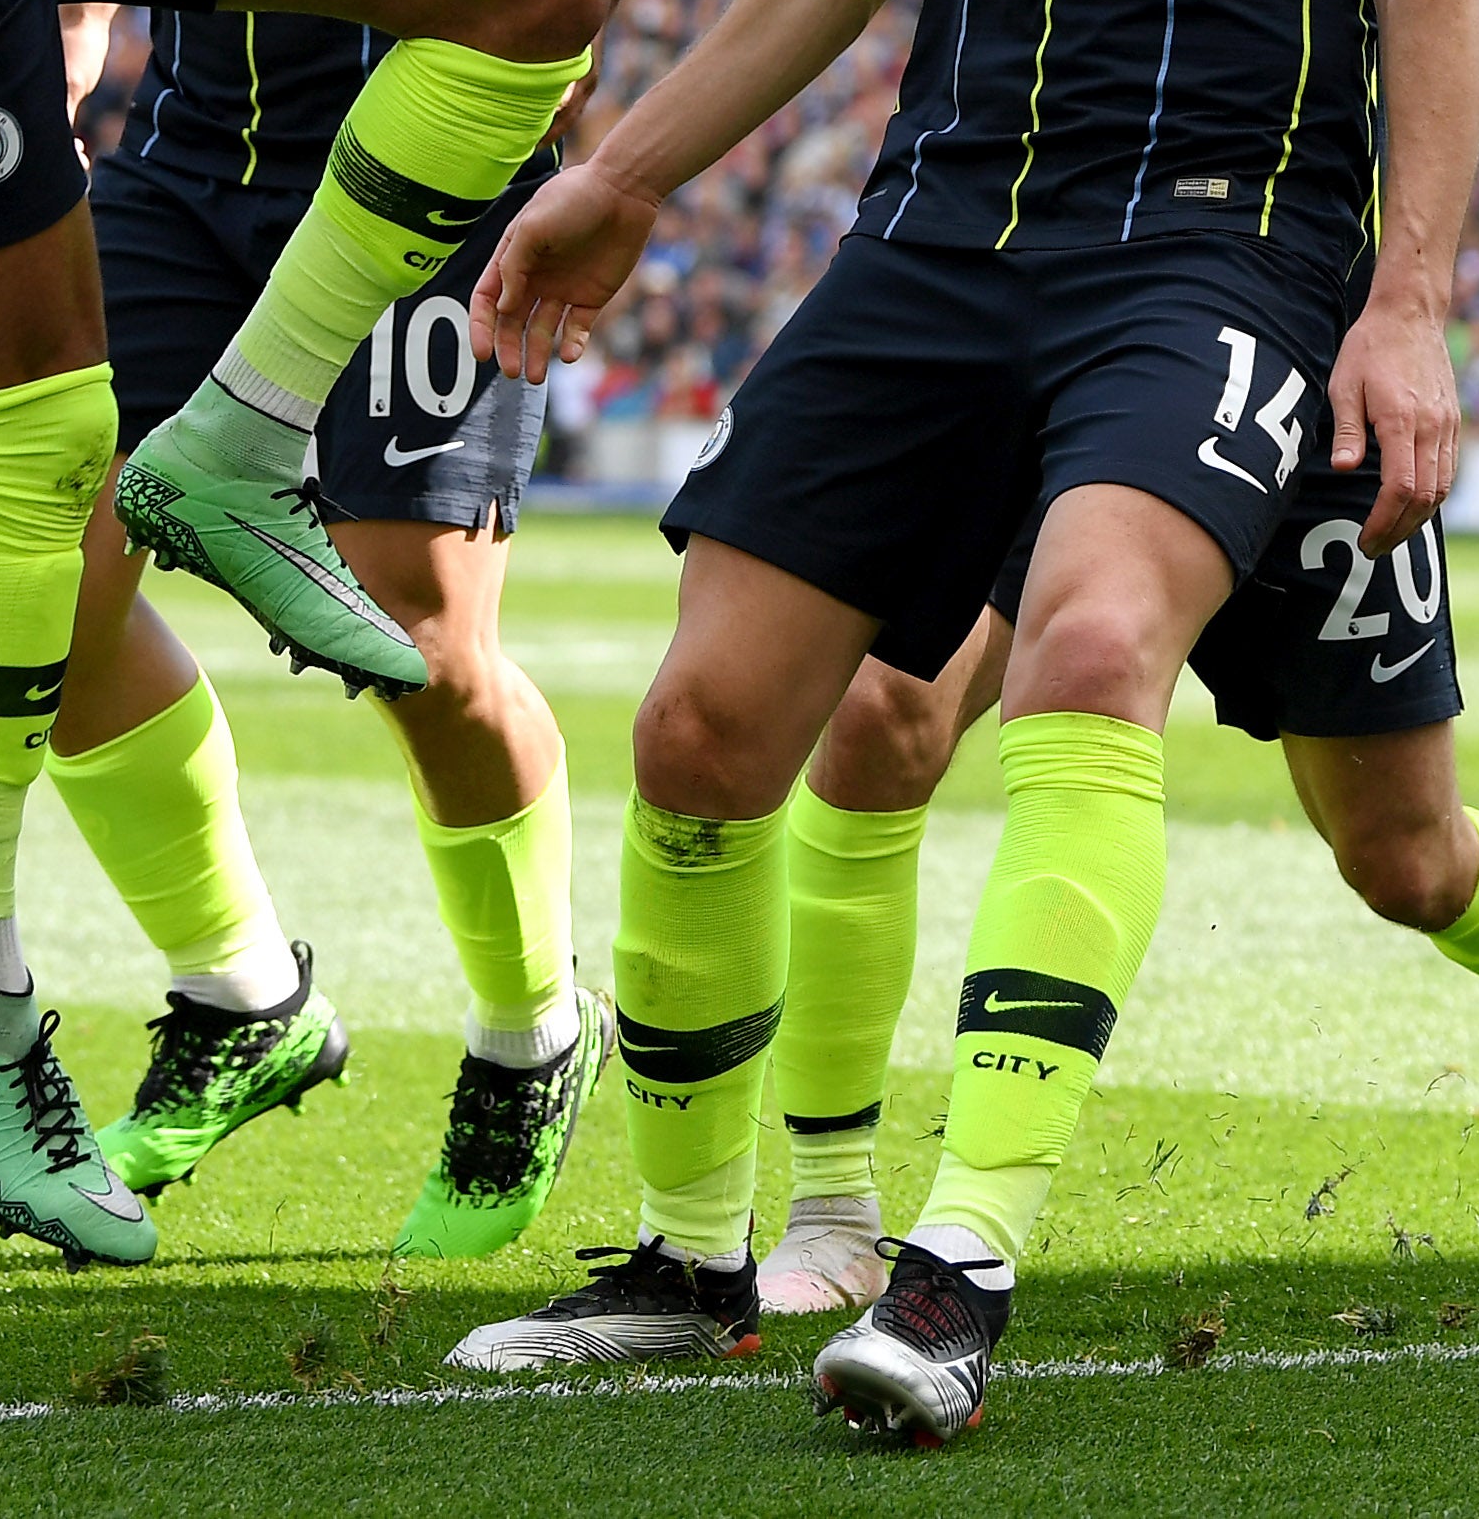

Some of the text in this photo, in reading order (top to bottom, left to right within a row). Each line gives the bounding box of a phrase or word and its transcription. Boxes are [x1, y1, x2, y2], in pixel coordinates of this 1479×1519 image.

[403, 250, 448, 272] CIT
[368, 294, 477, 419] 10
[1213, 325, 1306, 491] 14
[1300, 518, 1441, 641] 20
[625, 1078, 694, 1111] CITY
[972, 1050, 1060, 1081] CITY
